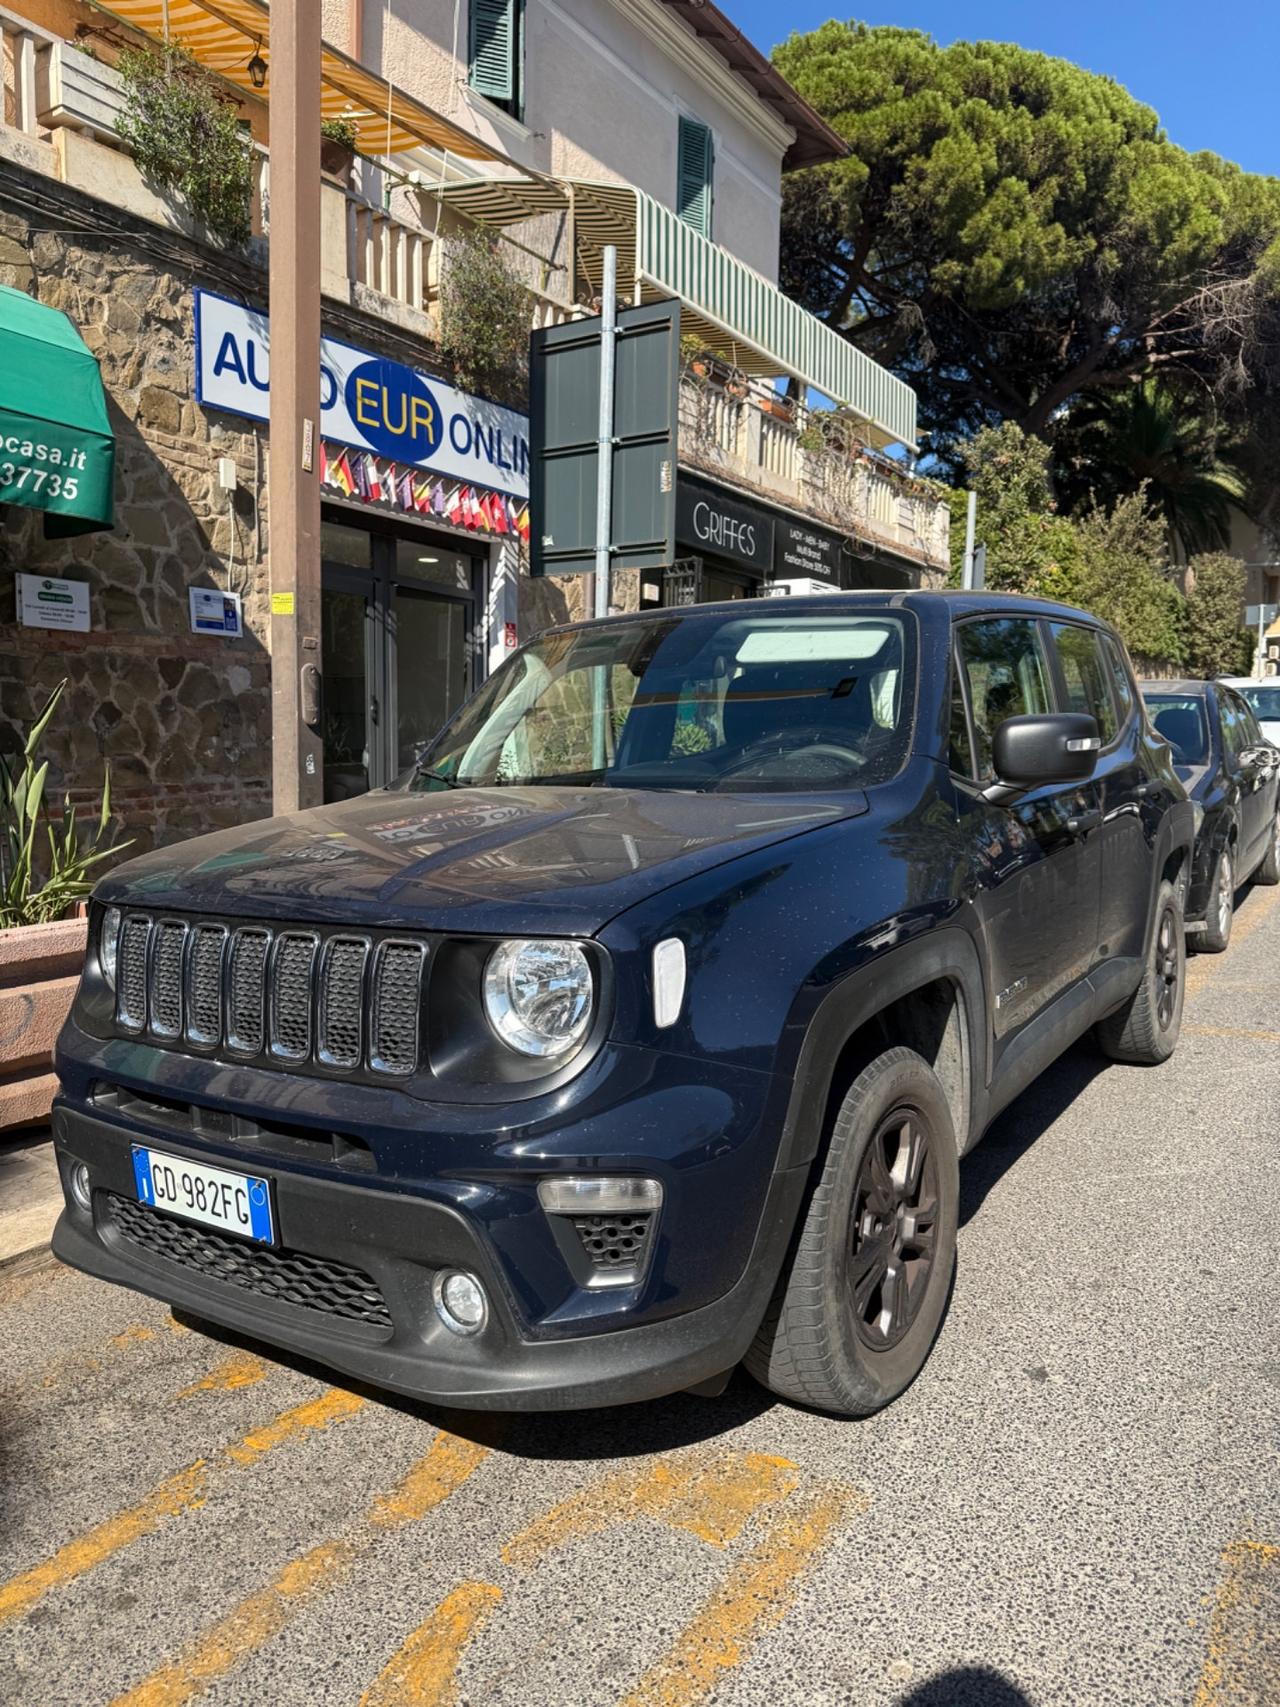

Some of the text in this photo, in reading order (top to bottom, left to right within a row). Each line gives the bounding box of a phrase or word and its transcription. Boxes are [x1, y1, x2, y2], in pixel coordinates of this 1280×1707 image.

[213, 331, 338, 411] AUO
[356, 378, 435, 445] EUR
[0, 434, 87, 471] casa.it
[0, 462, 79, 500] 37735
[152, 1164, 177, 1202] GD
[181, 1173, 249, 1225] 982FG
